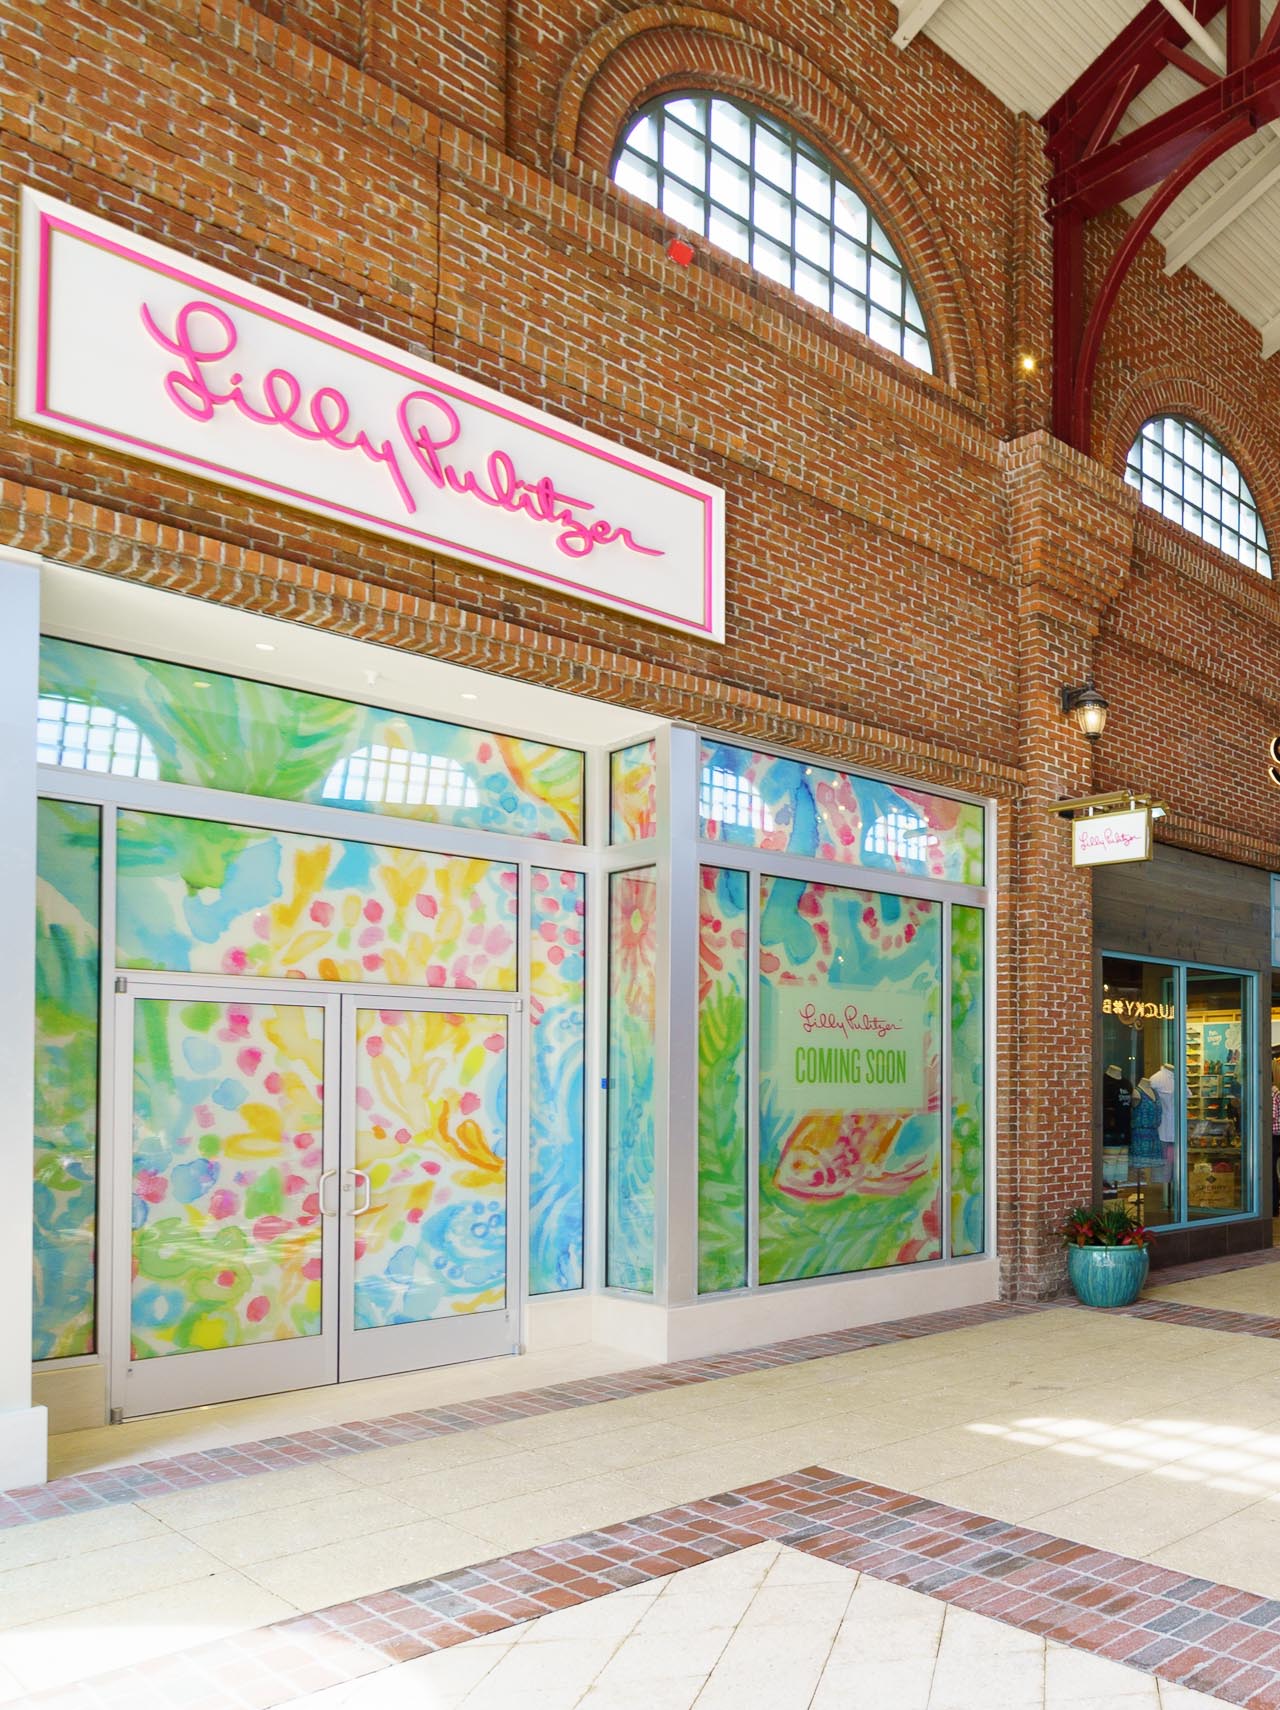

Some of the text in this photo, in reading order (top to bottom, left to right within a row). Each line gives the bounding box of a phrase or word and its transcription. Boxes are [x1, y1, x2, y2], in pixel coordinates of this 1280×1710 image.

[141, 301, 665, 558] Lilly Pulitzer
[799, 1003, 904, 1040] Lilly Pulitzer
[795, 1046, 907, 1085] COMING SOON
